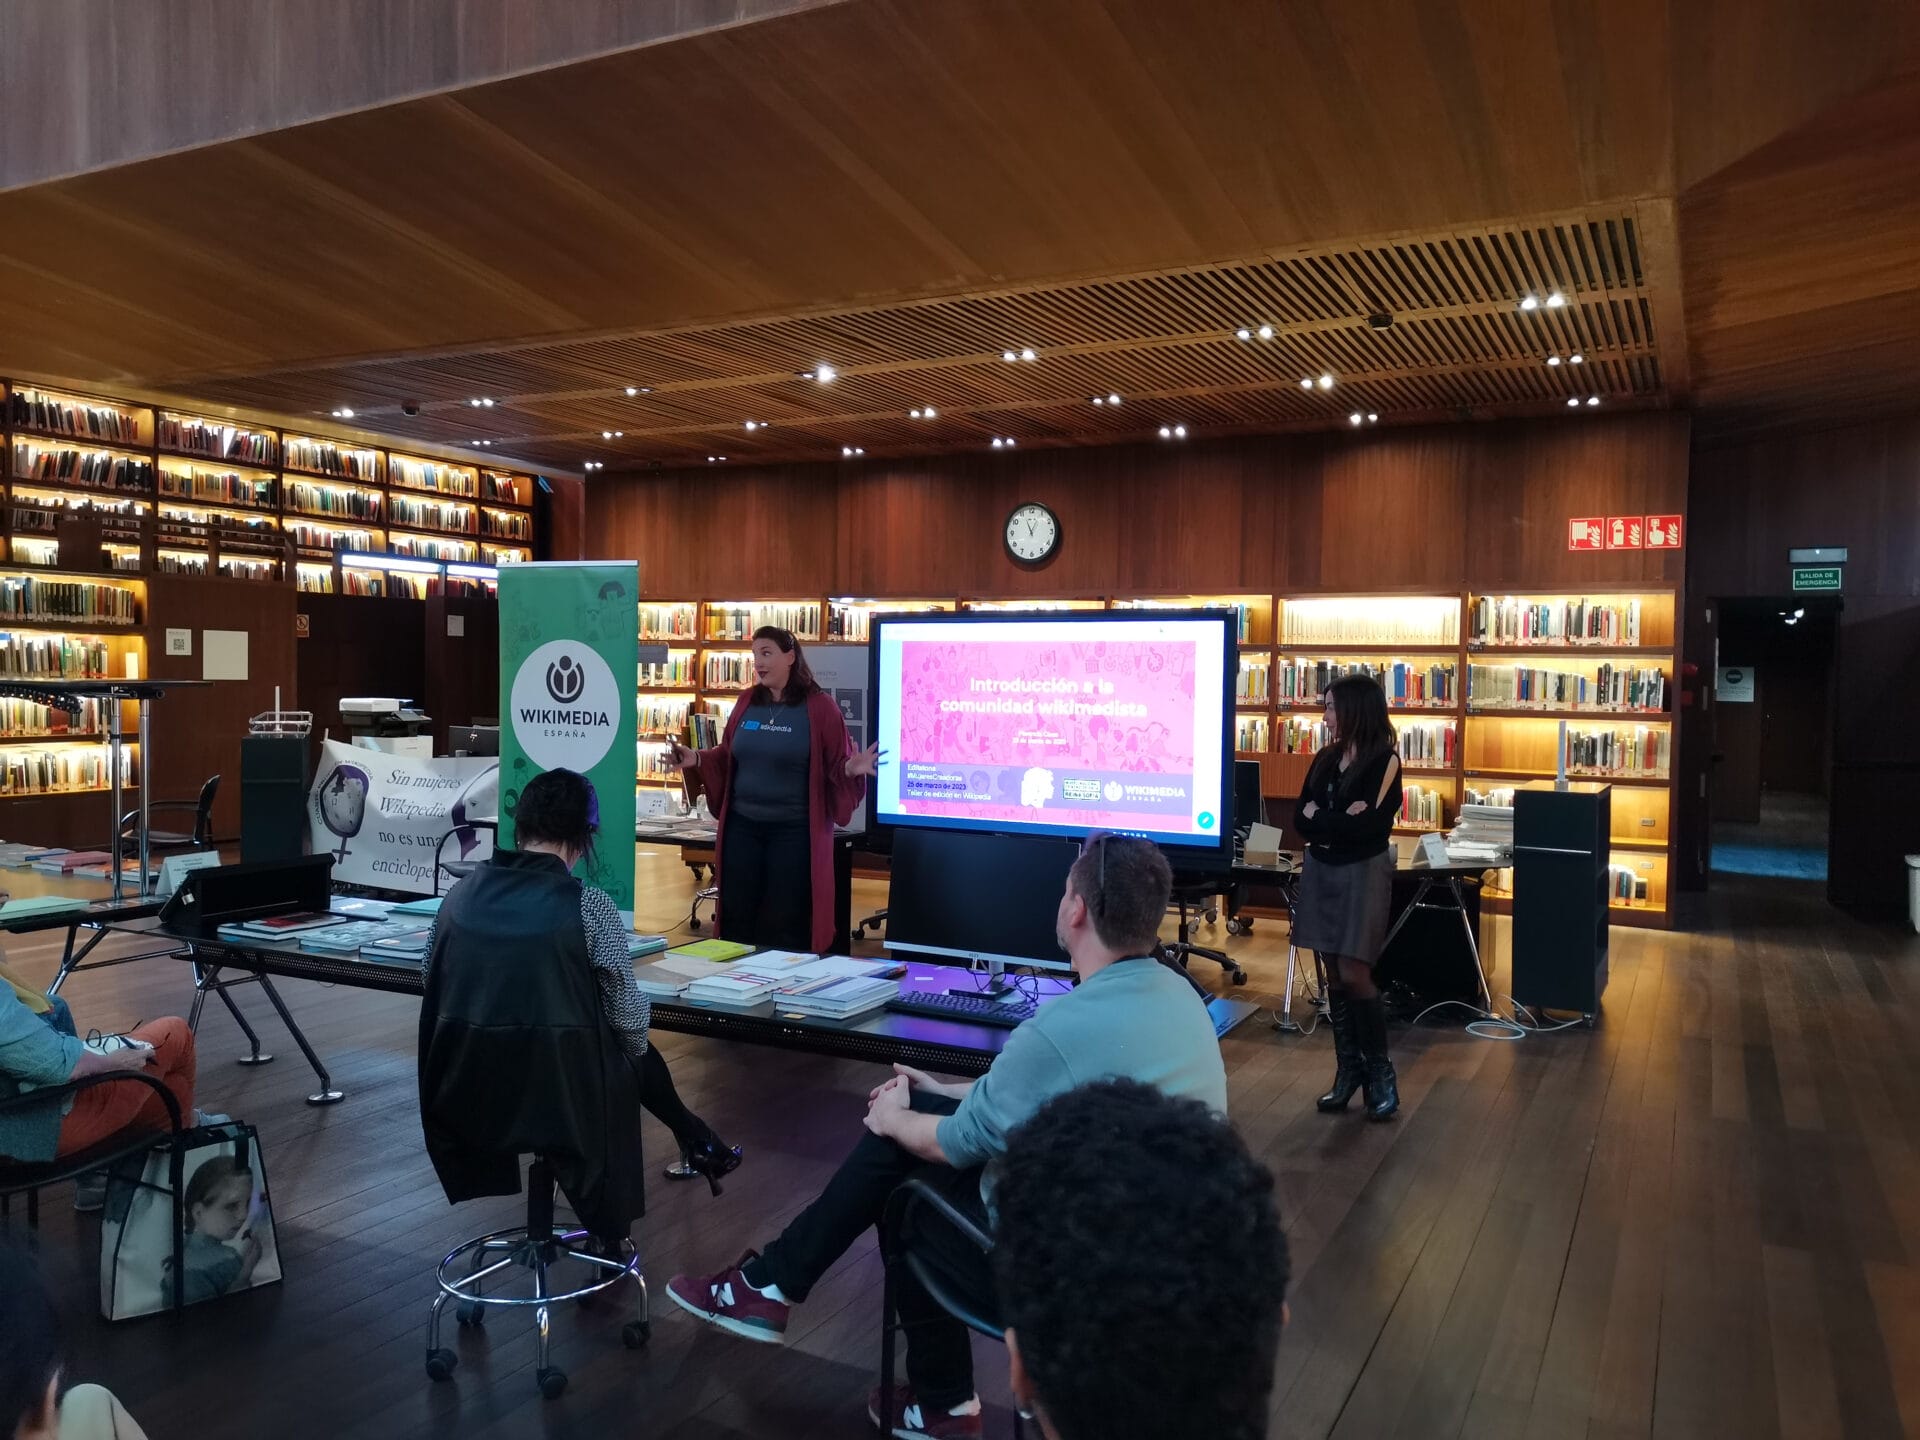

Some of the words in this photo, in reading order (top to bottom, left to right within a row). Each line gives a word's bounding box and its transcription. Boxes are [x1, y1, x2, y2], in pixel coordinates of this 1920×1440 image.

[970, 676, 1078, 694] Introducción
[1083, 681, 1094, 693] a
[1098, 678, 1115, 695] la
[939, 698, 1034, 714] comunidad
[1038, 699, 1148, 717] wikimedista
[520, 708, 610, 726] WIKIMEDIA
[544, 729, 586, 738] ESPAÑA
[386, 769, 411, 786] Sin
[412, 774, 462, 793] mujeres
[963, 792, 992, 801] Wikipedia
[1124, 785, 1186, 797] WIKIMEDIA
[380, 796, 446, 820] Wikipedia
[379, 831, 395, 843] no
[399, 834, 413, 846] es
[416, 836, 441, 847] una
[903, 1404, 925, 1430] N
